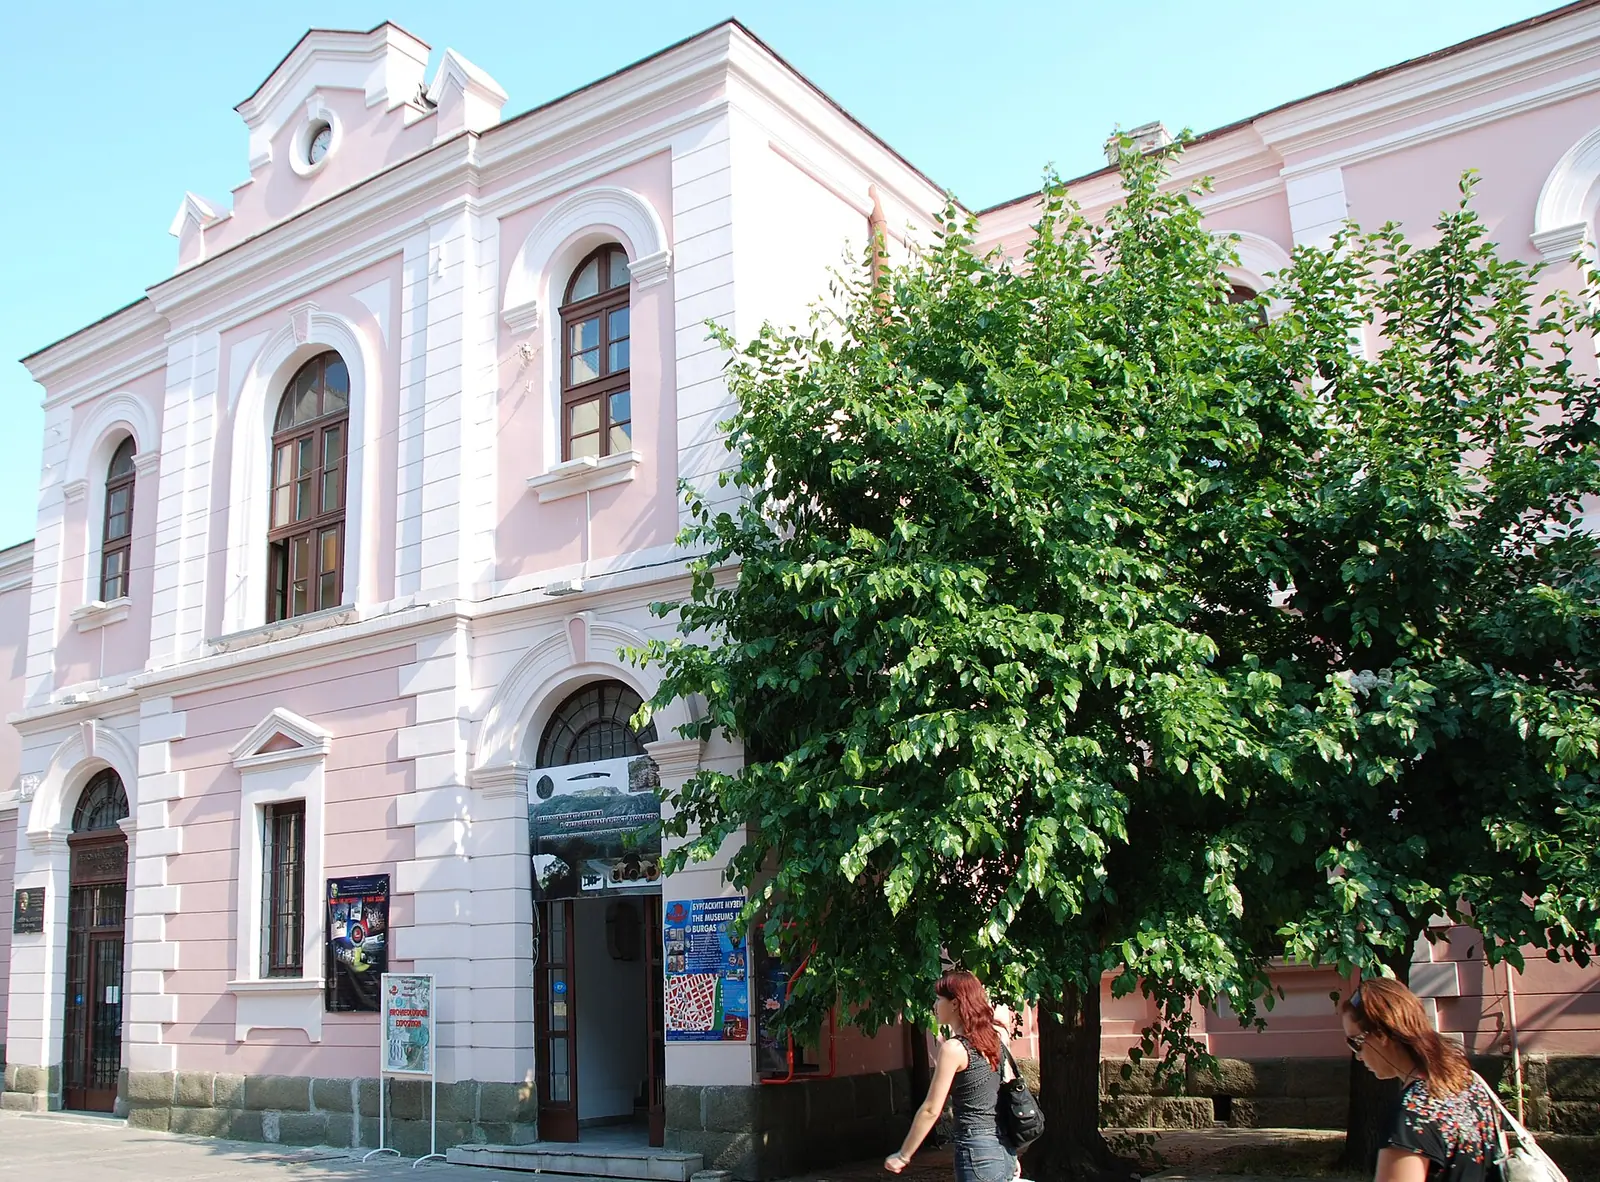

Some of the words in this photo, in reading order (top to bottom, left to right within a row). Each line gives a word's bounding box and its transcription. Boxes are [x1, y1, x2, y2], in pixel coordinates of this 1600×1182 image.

[692, 902, 724, 911] БУРГАСКИТЕ
[704, 912, 734, 922] MUSEUMS
[692, 924, 717, 932] BURGAS
